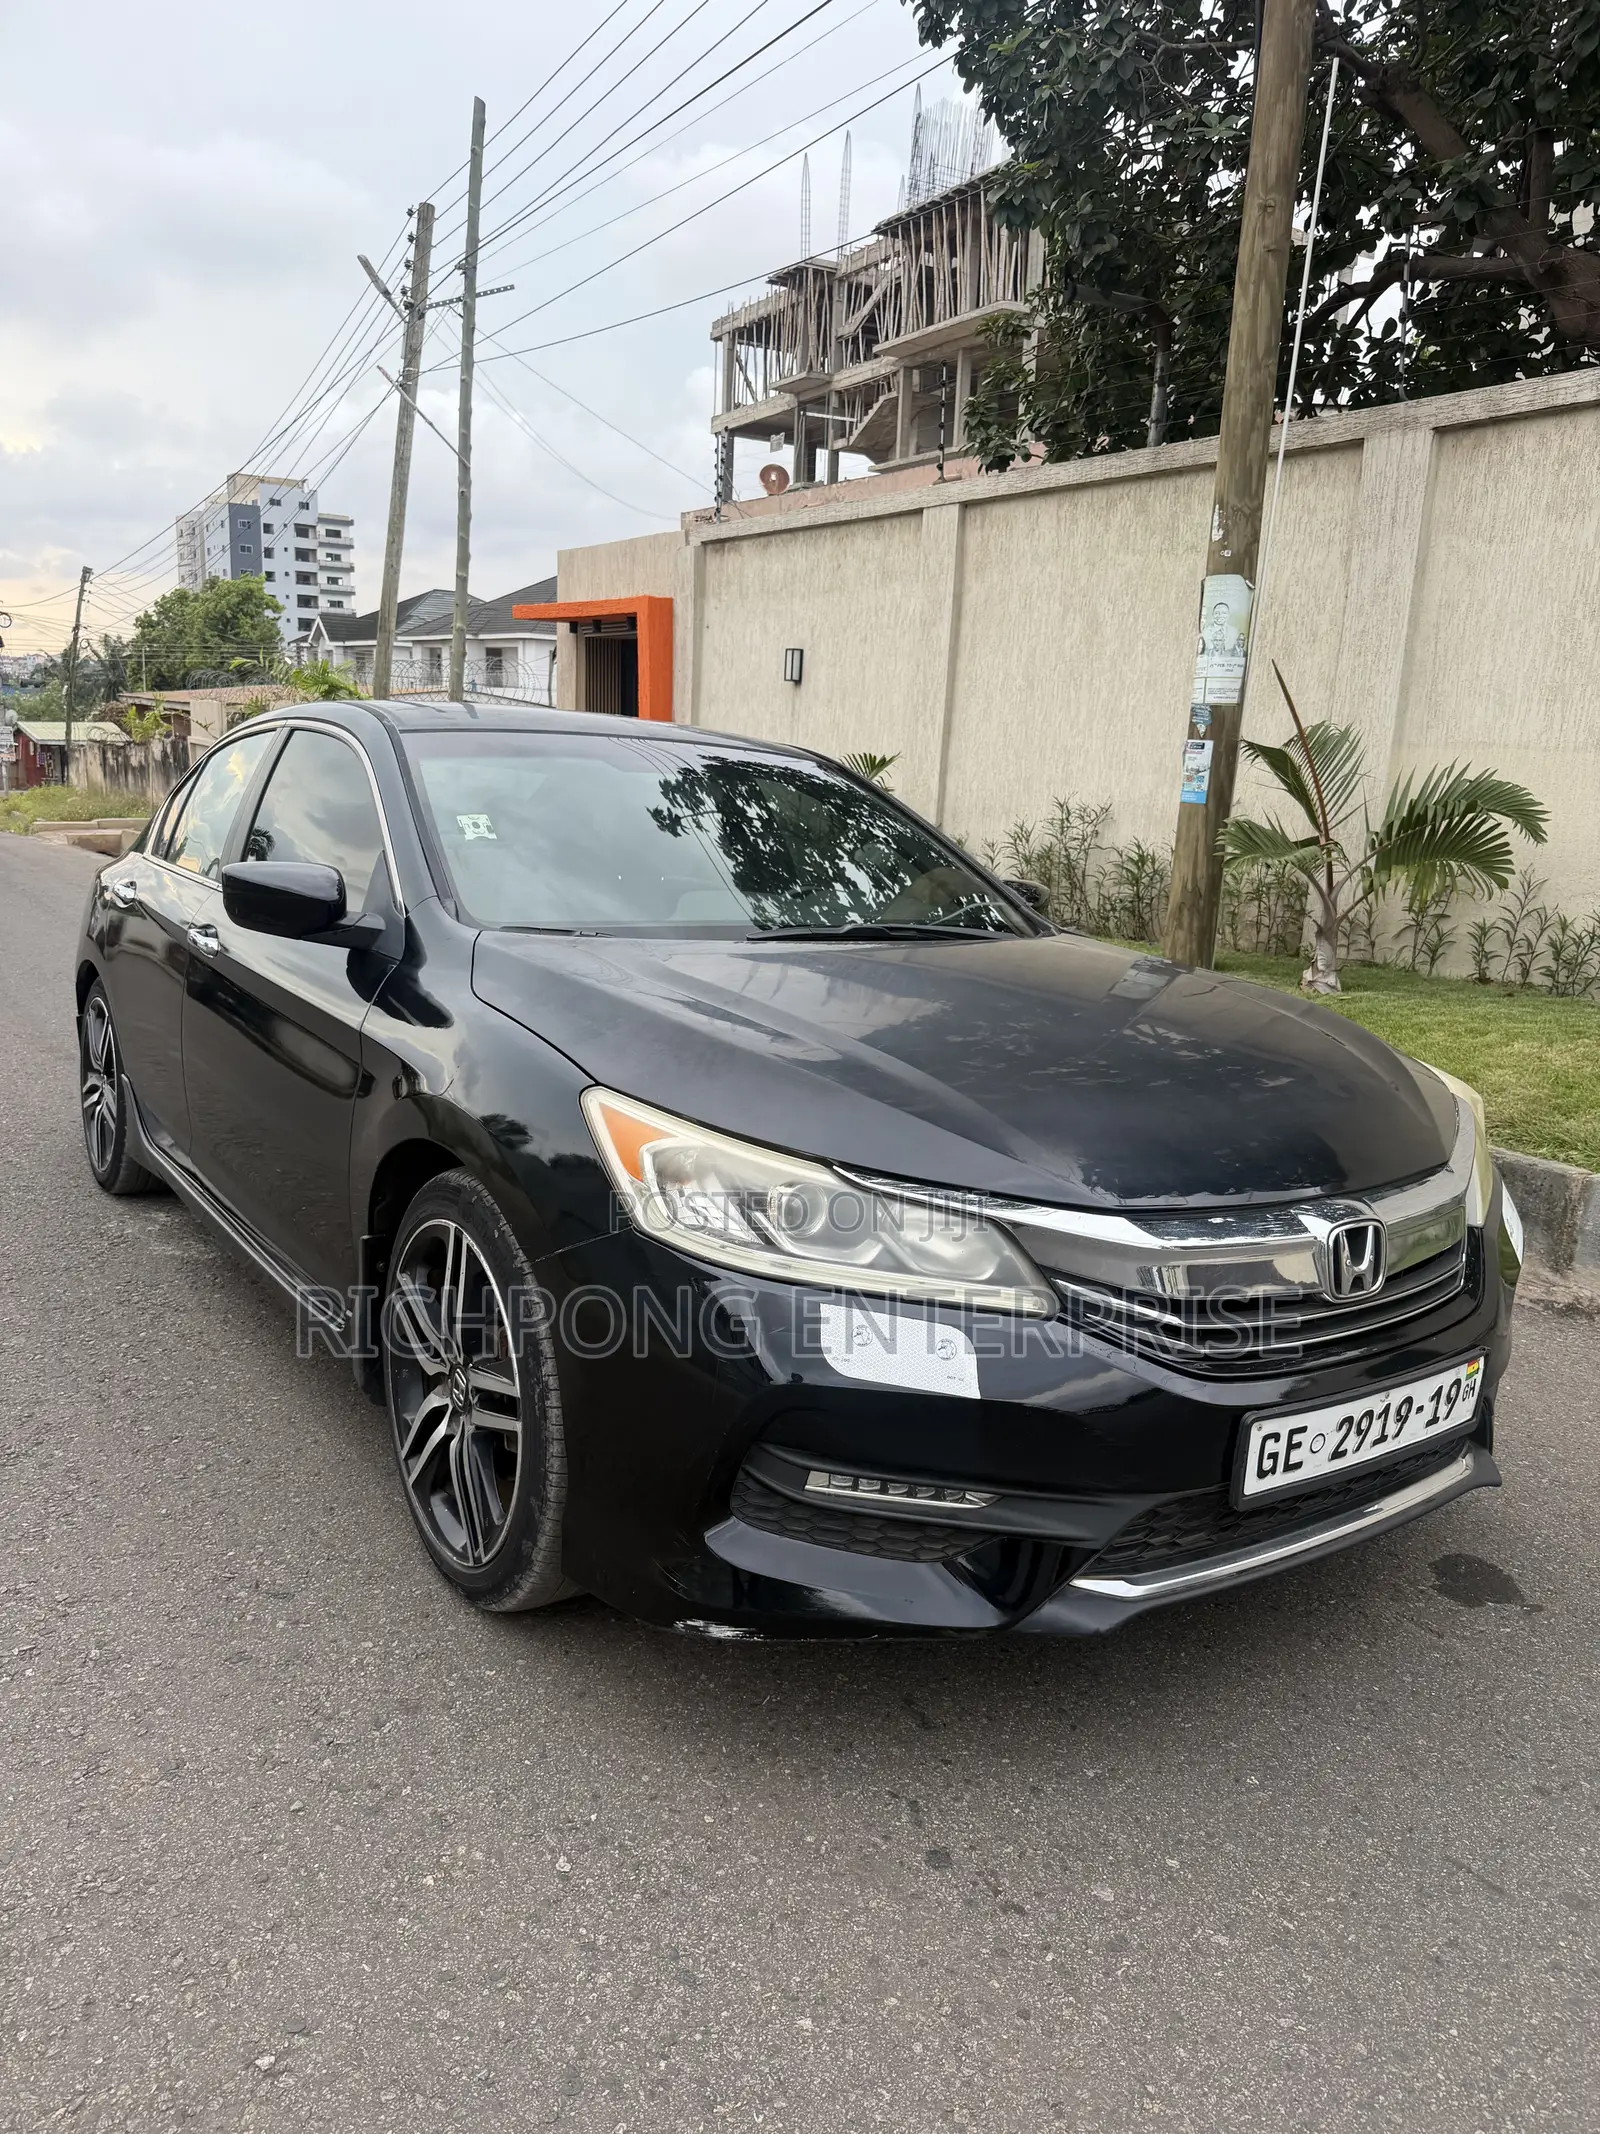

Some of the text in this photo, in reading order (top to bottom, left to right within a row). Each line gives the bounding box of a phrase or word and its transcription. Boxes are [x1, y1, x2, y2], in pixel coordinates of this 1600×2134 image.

[1462, 1378, 1477, 1402] GH
[1256, 1378, 1462, 1479] GE 2919-19
